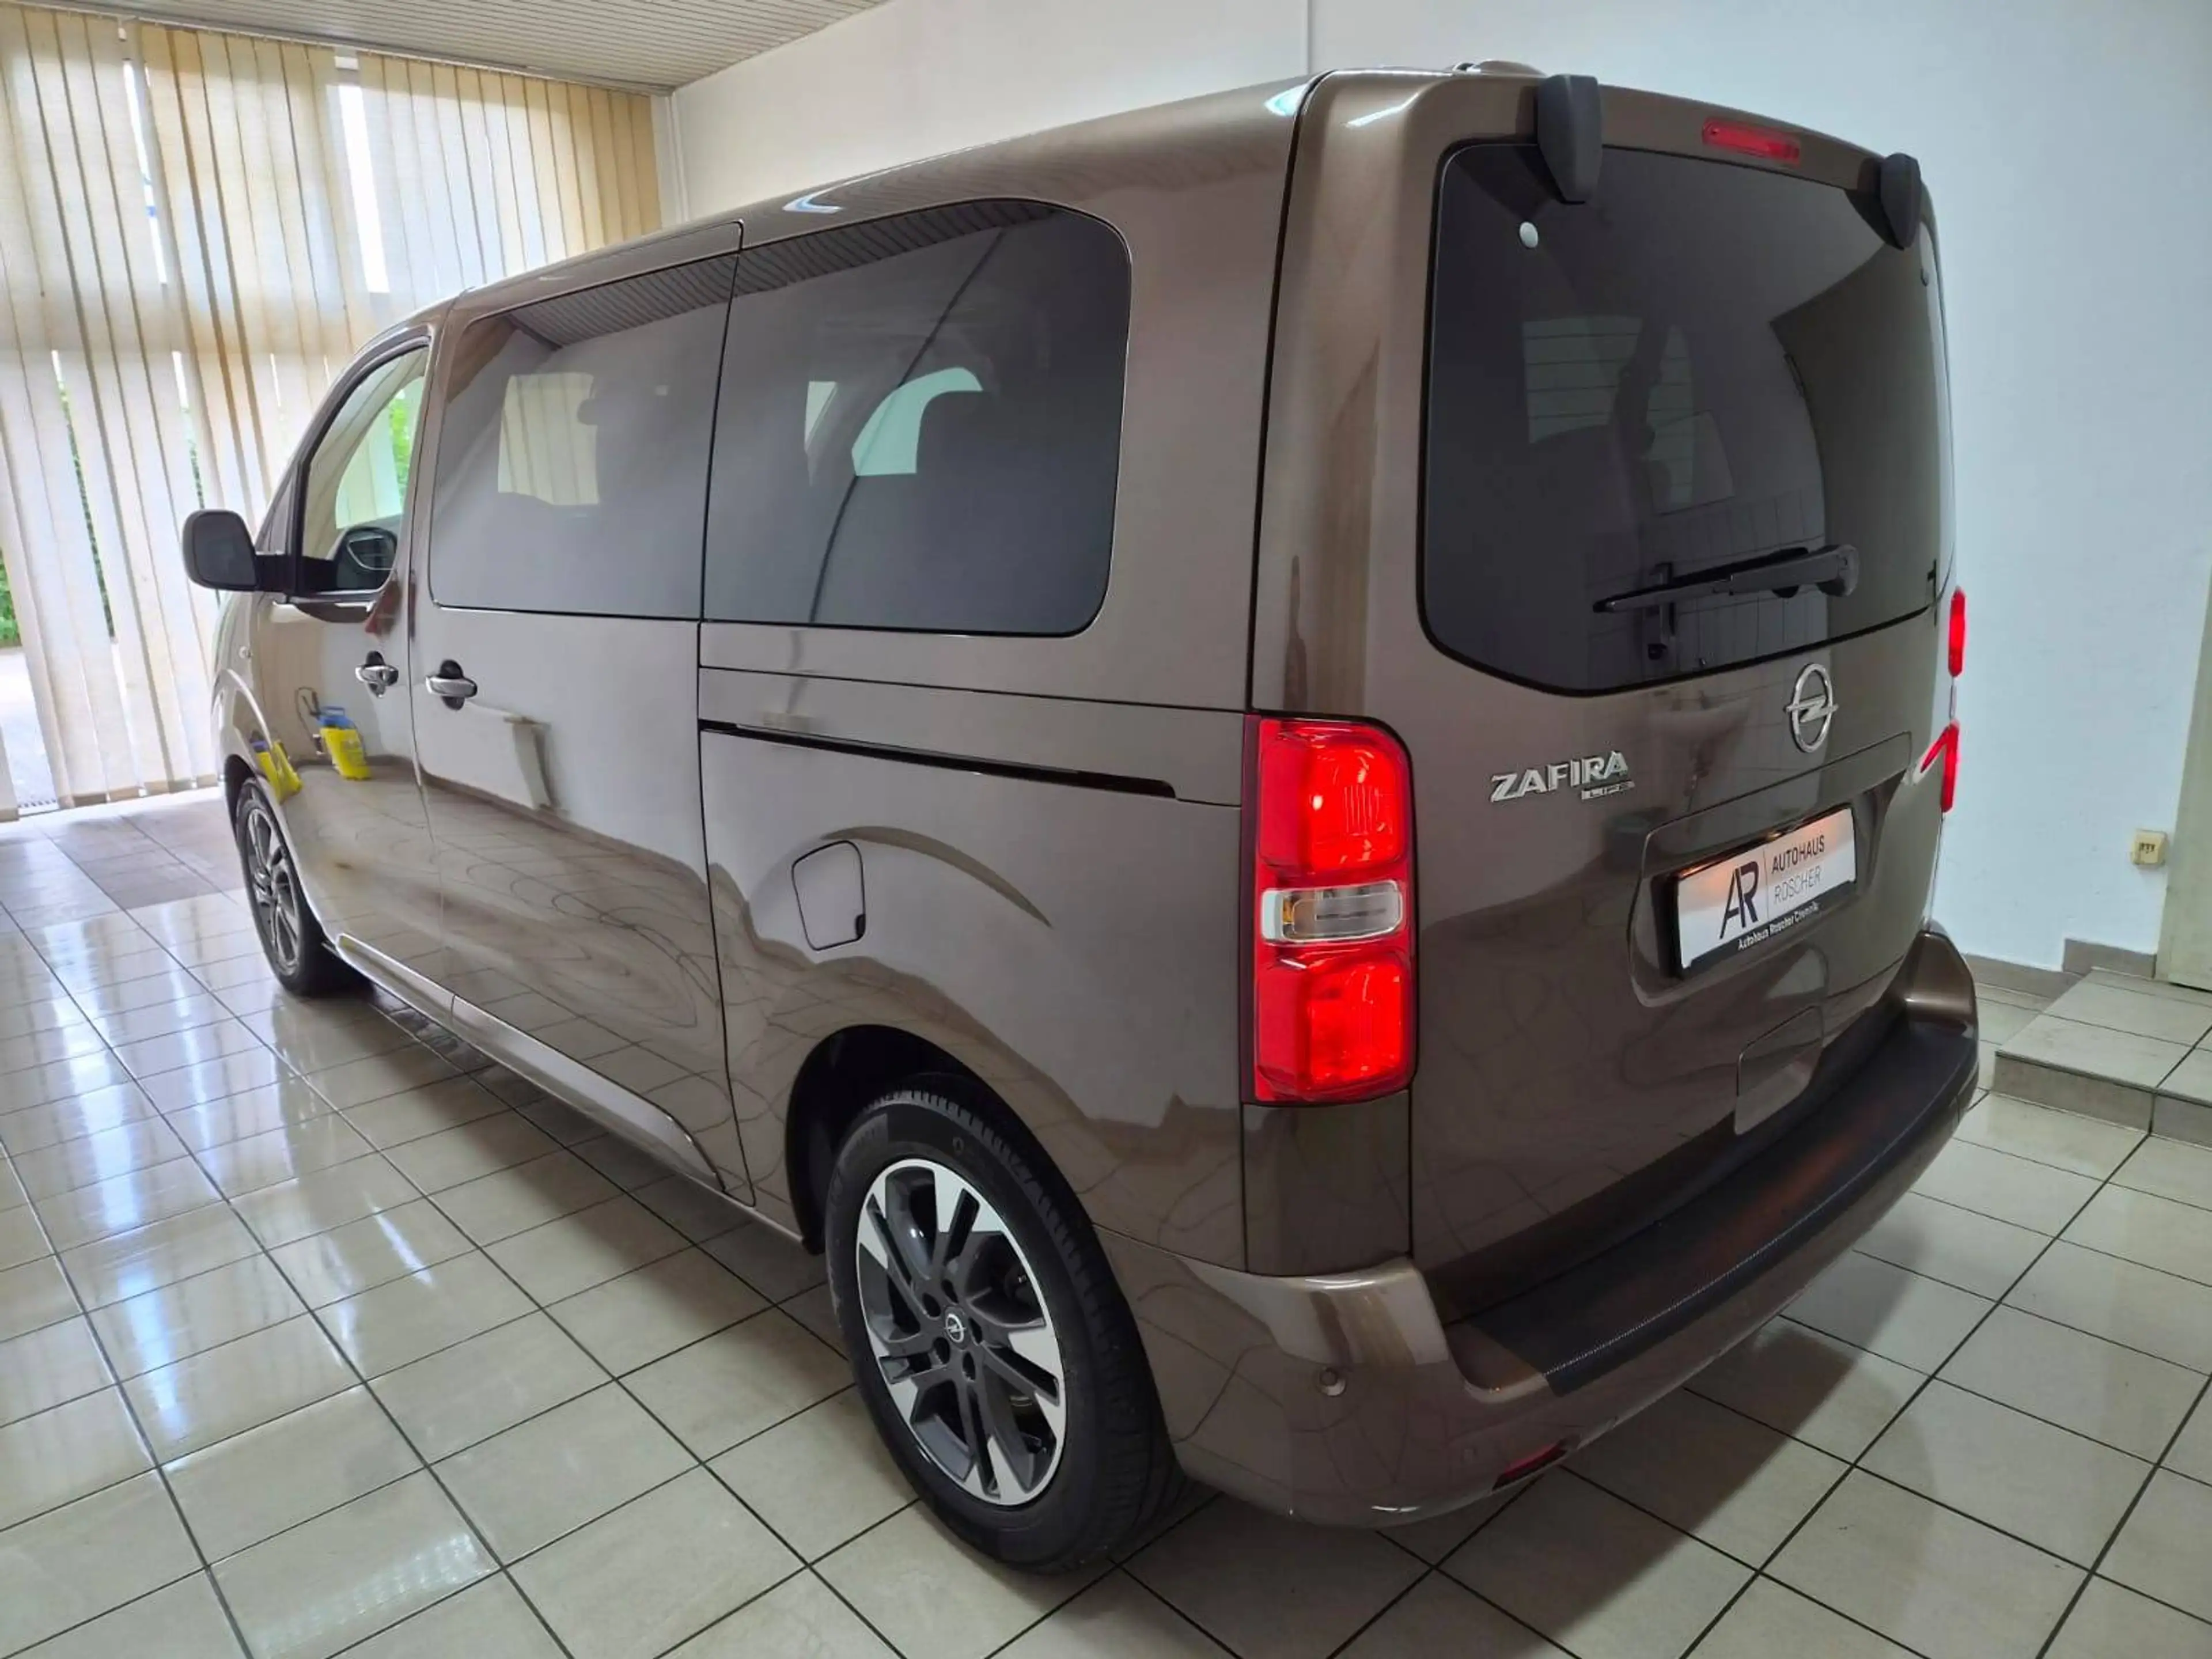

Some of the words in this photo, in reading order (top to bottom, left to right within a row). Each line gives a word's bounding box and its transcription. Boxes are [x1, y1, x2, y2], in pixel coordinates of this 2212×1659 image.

[1490, 749, 1629, 802] ZAFIRA
[1771, 835, 1825, 874] AUTOHAUS
[1719, 861, 1759, 940] AR
